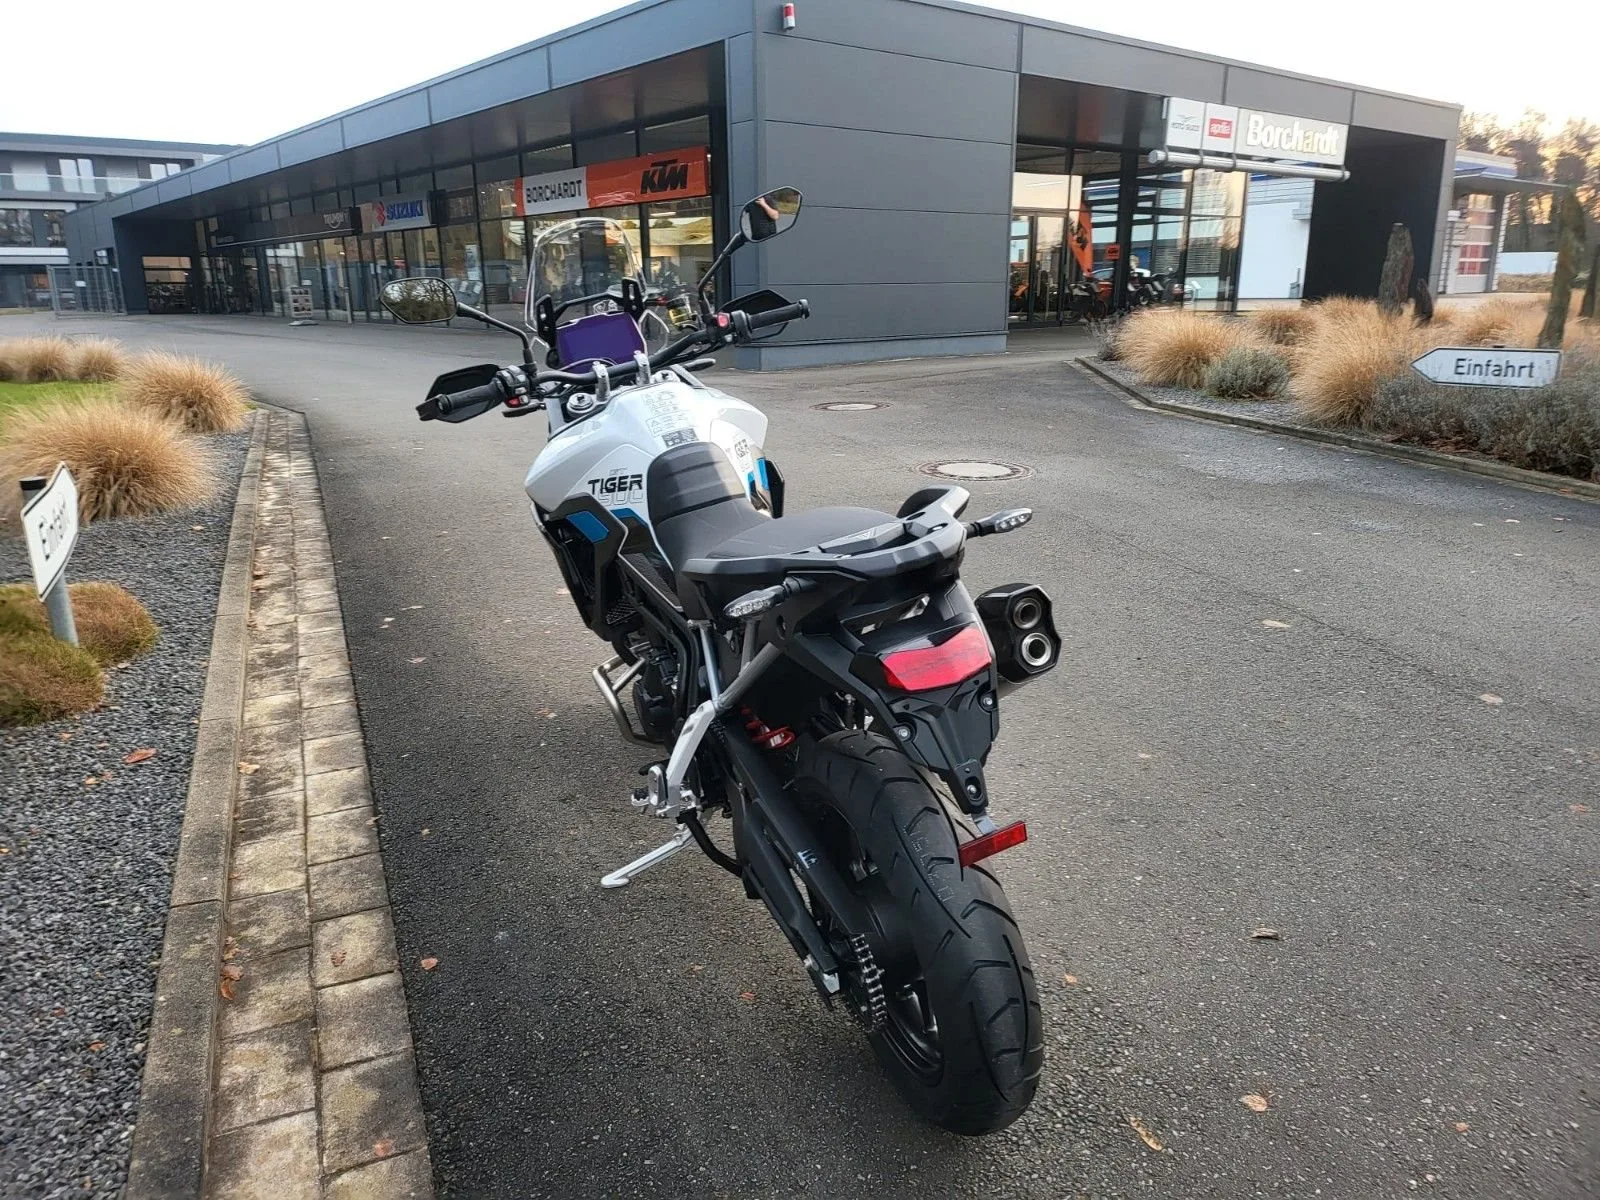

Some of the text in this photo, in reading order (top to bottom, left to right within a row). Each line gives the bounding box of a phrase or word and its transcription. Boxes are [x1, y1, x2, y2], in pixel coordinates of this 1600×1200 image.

[1247, 114, 1340, 156] Borchardt
[640, 159, 688, 194] KTM
[526, 179, 582, 203] BORCHARDT
[386, 200, 424, 220] SUZUKI
[1453, 358, 1535, 378] Einfahrt
[587, 474, 643, 495] TIGER
